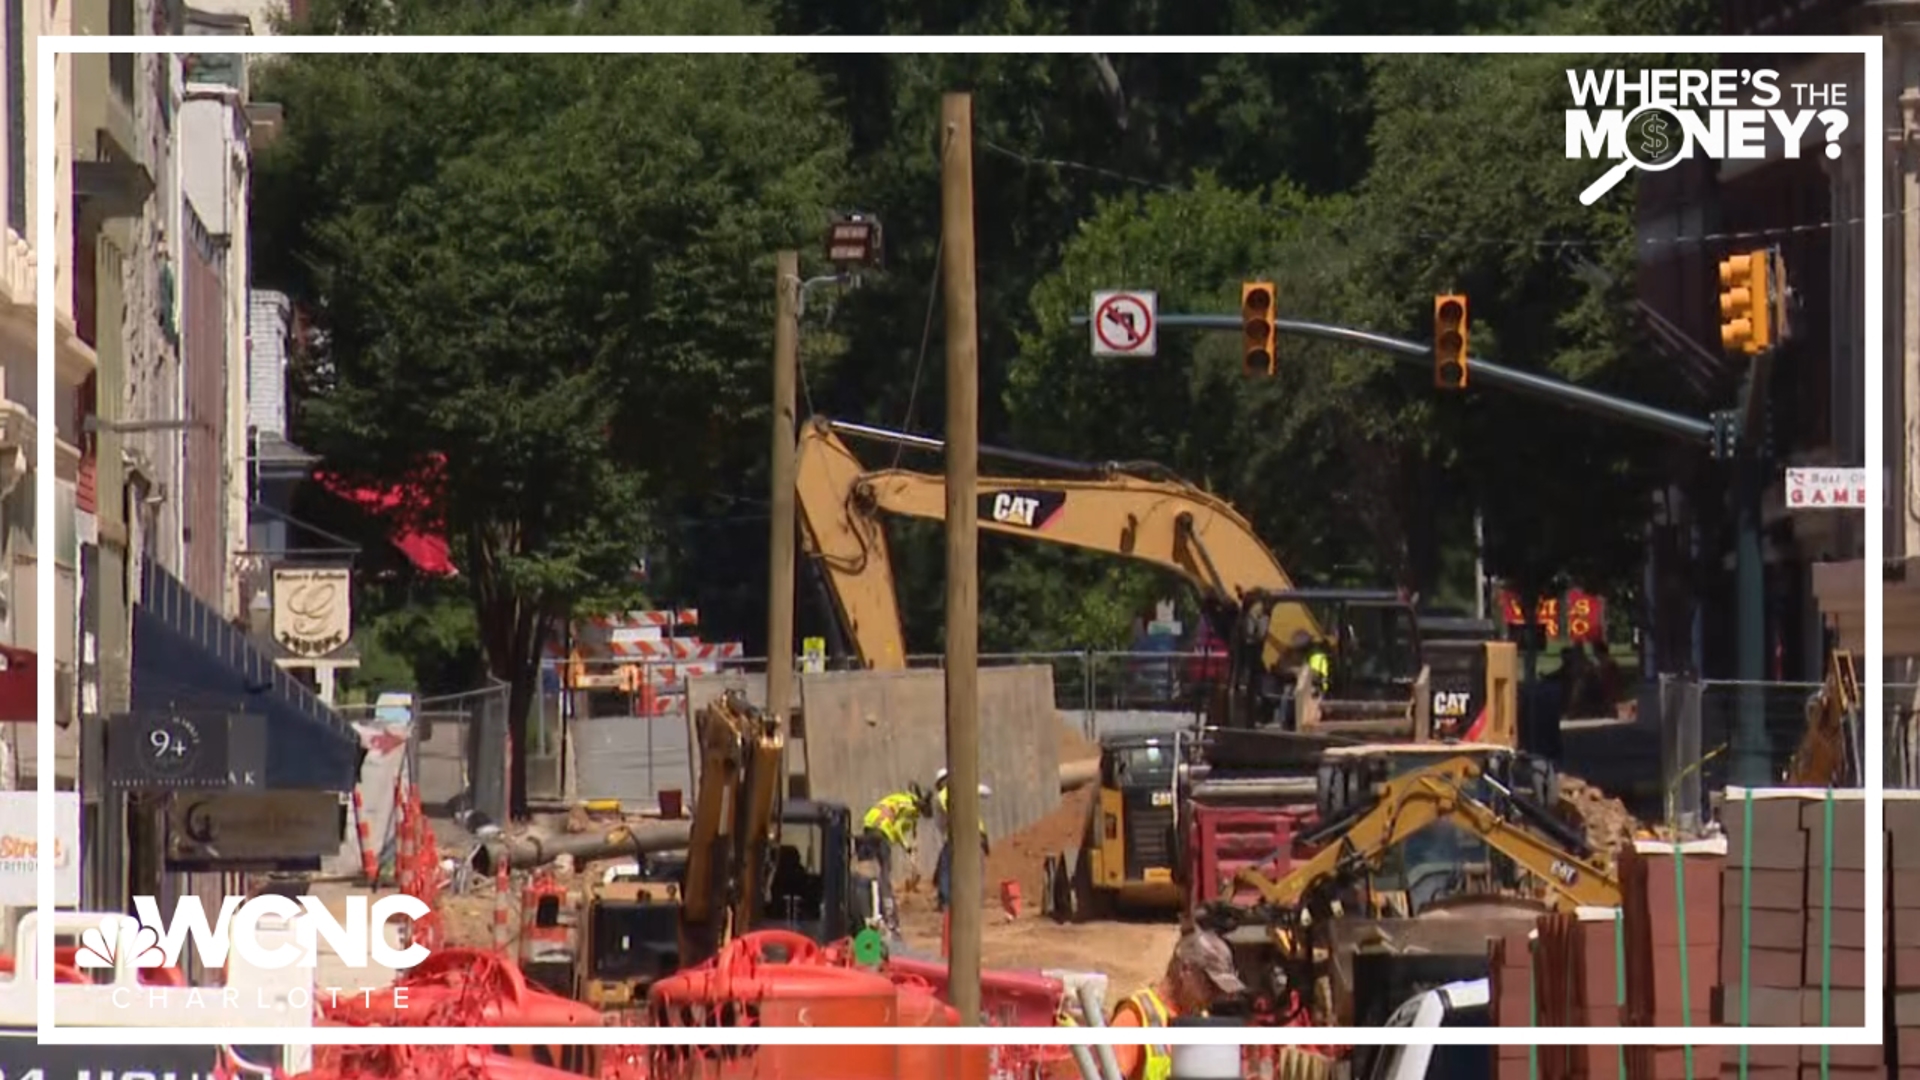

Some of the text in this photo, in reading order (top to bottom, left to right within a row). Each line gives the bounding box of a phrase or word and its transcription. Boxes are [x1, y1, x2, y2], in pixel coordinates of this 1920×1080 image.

[993, 492, 1040, 527] CAT
[1434, 690, 1470, 716] CAT
[150, 729, 187, 758] 9+
[1550, 860, 1576, 884] CAT
